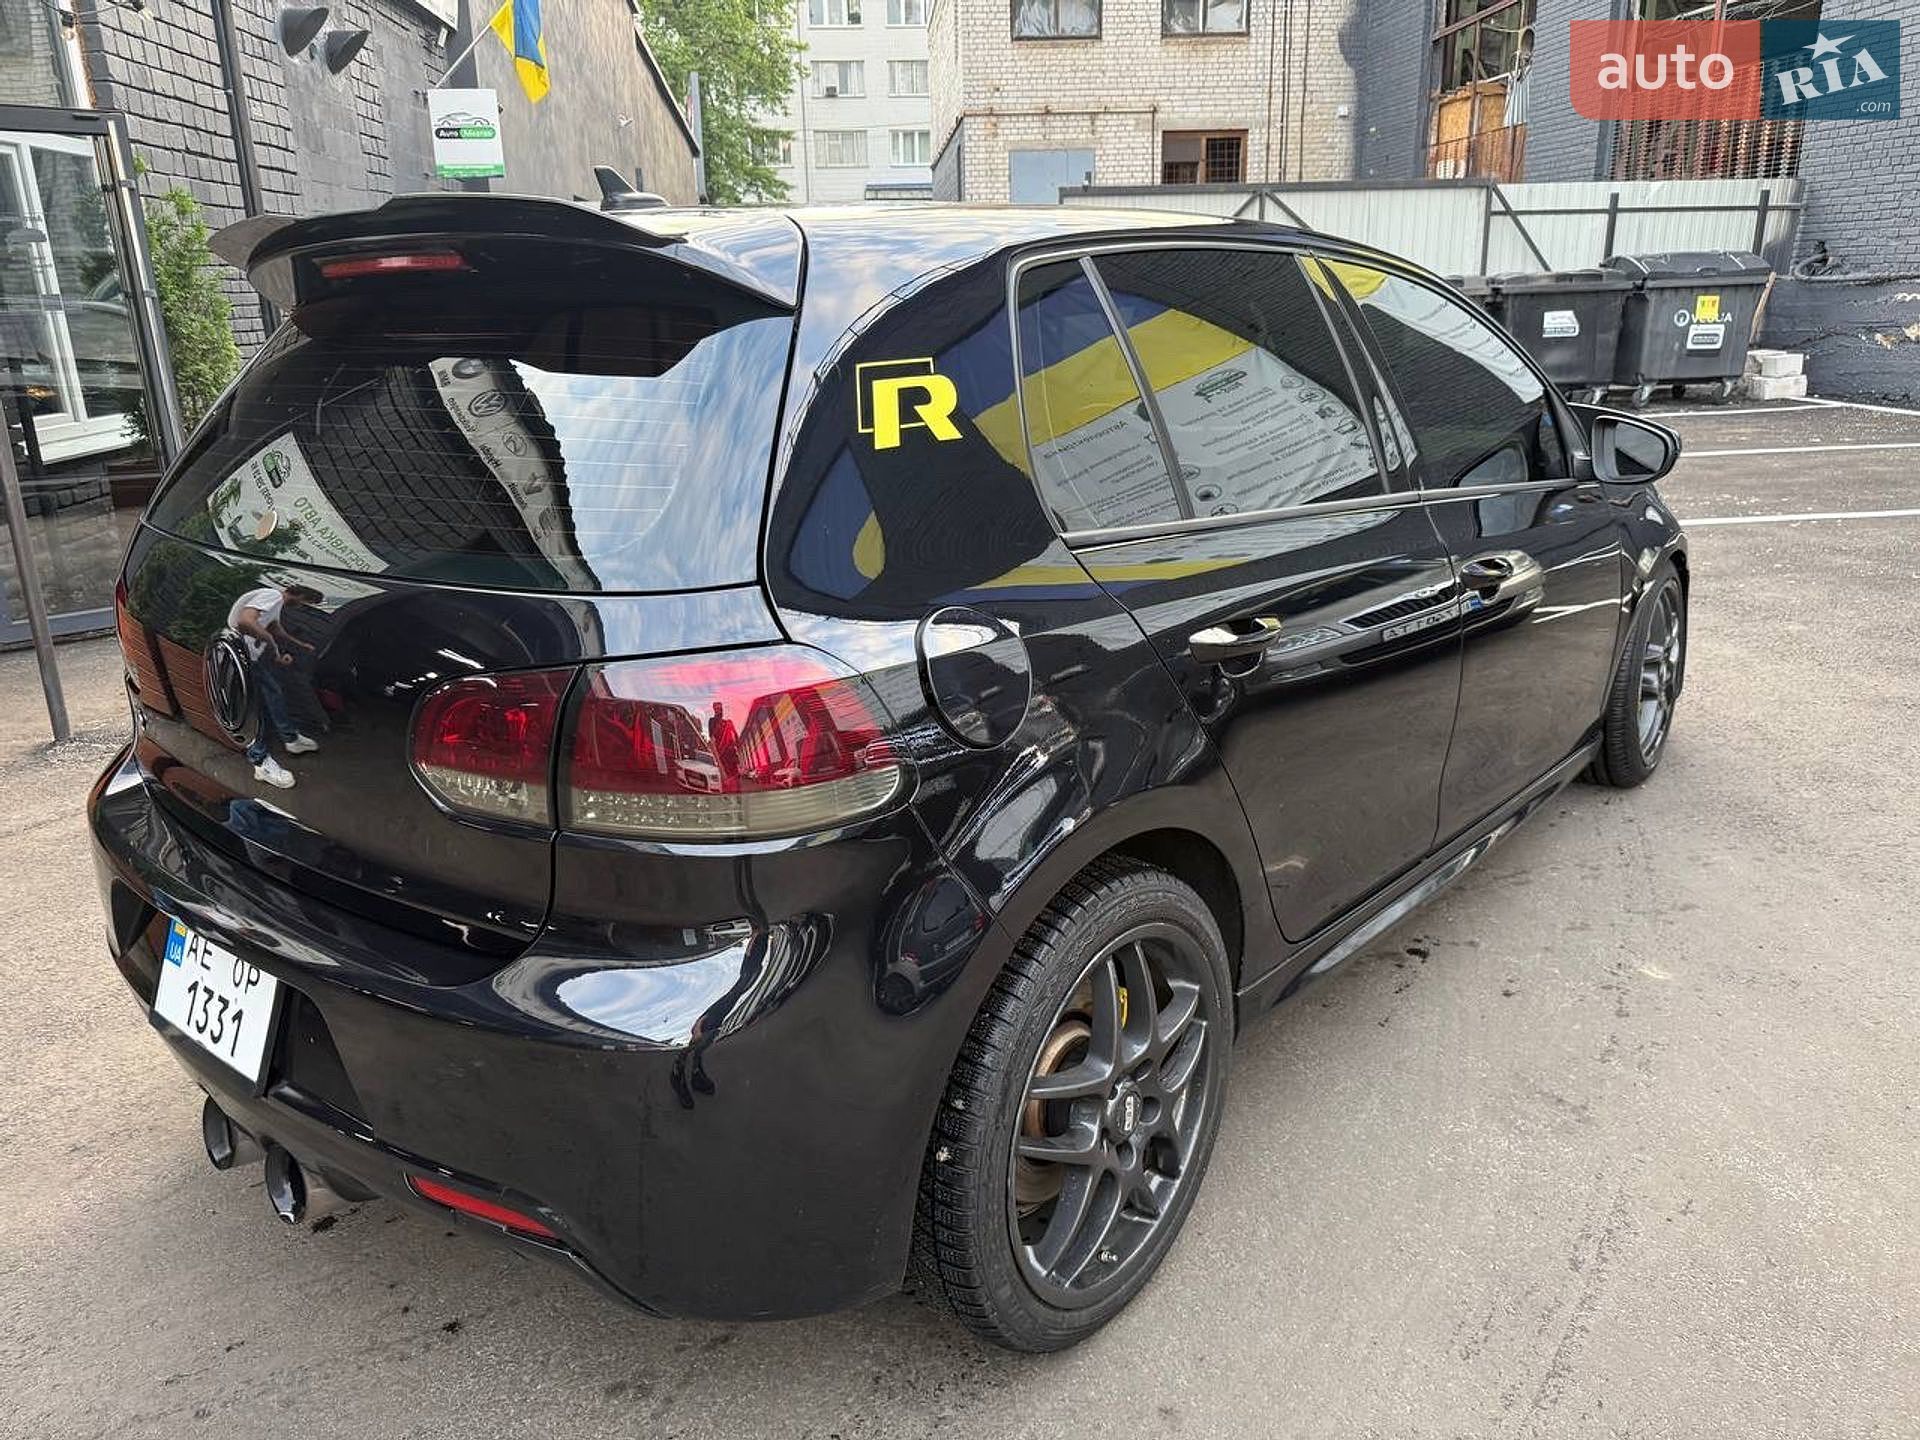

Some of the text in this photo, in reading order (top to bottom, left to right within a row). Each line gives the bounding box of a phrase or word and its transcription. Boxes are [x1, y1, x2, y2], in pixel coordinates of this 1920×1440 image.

[872, 373, 963, 450] R
[186, 933, 213, 971] AE
[187, 980, 244, 1057] 1331
